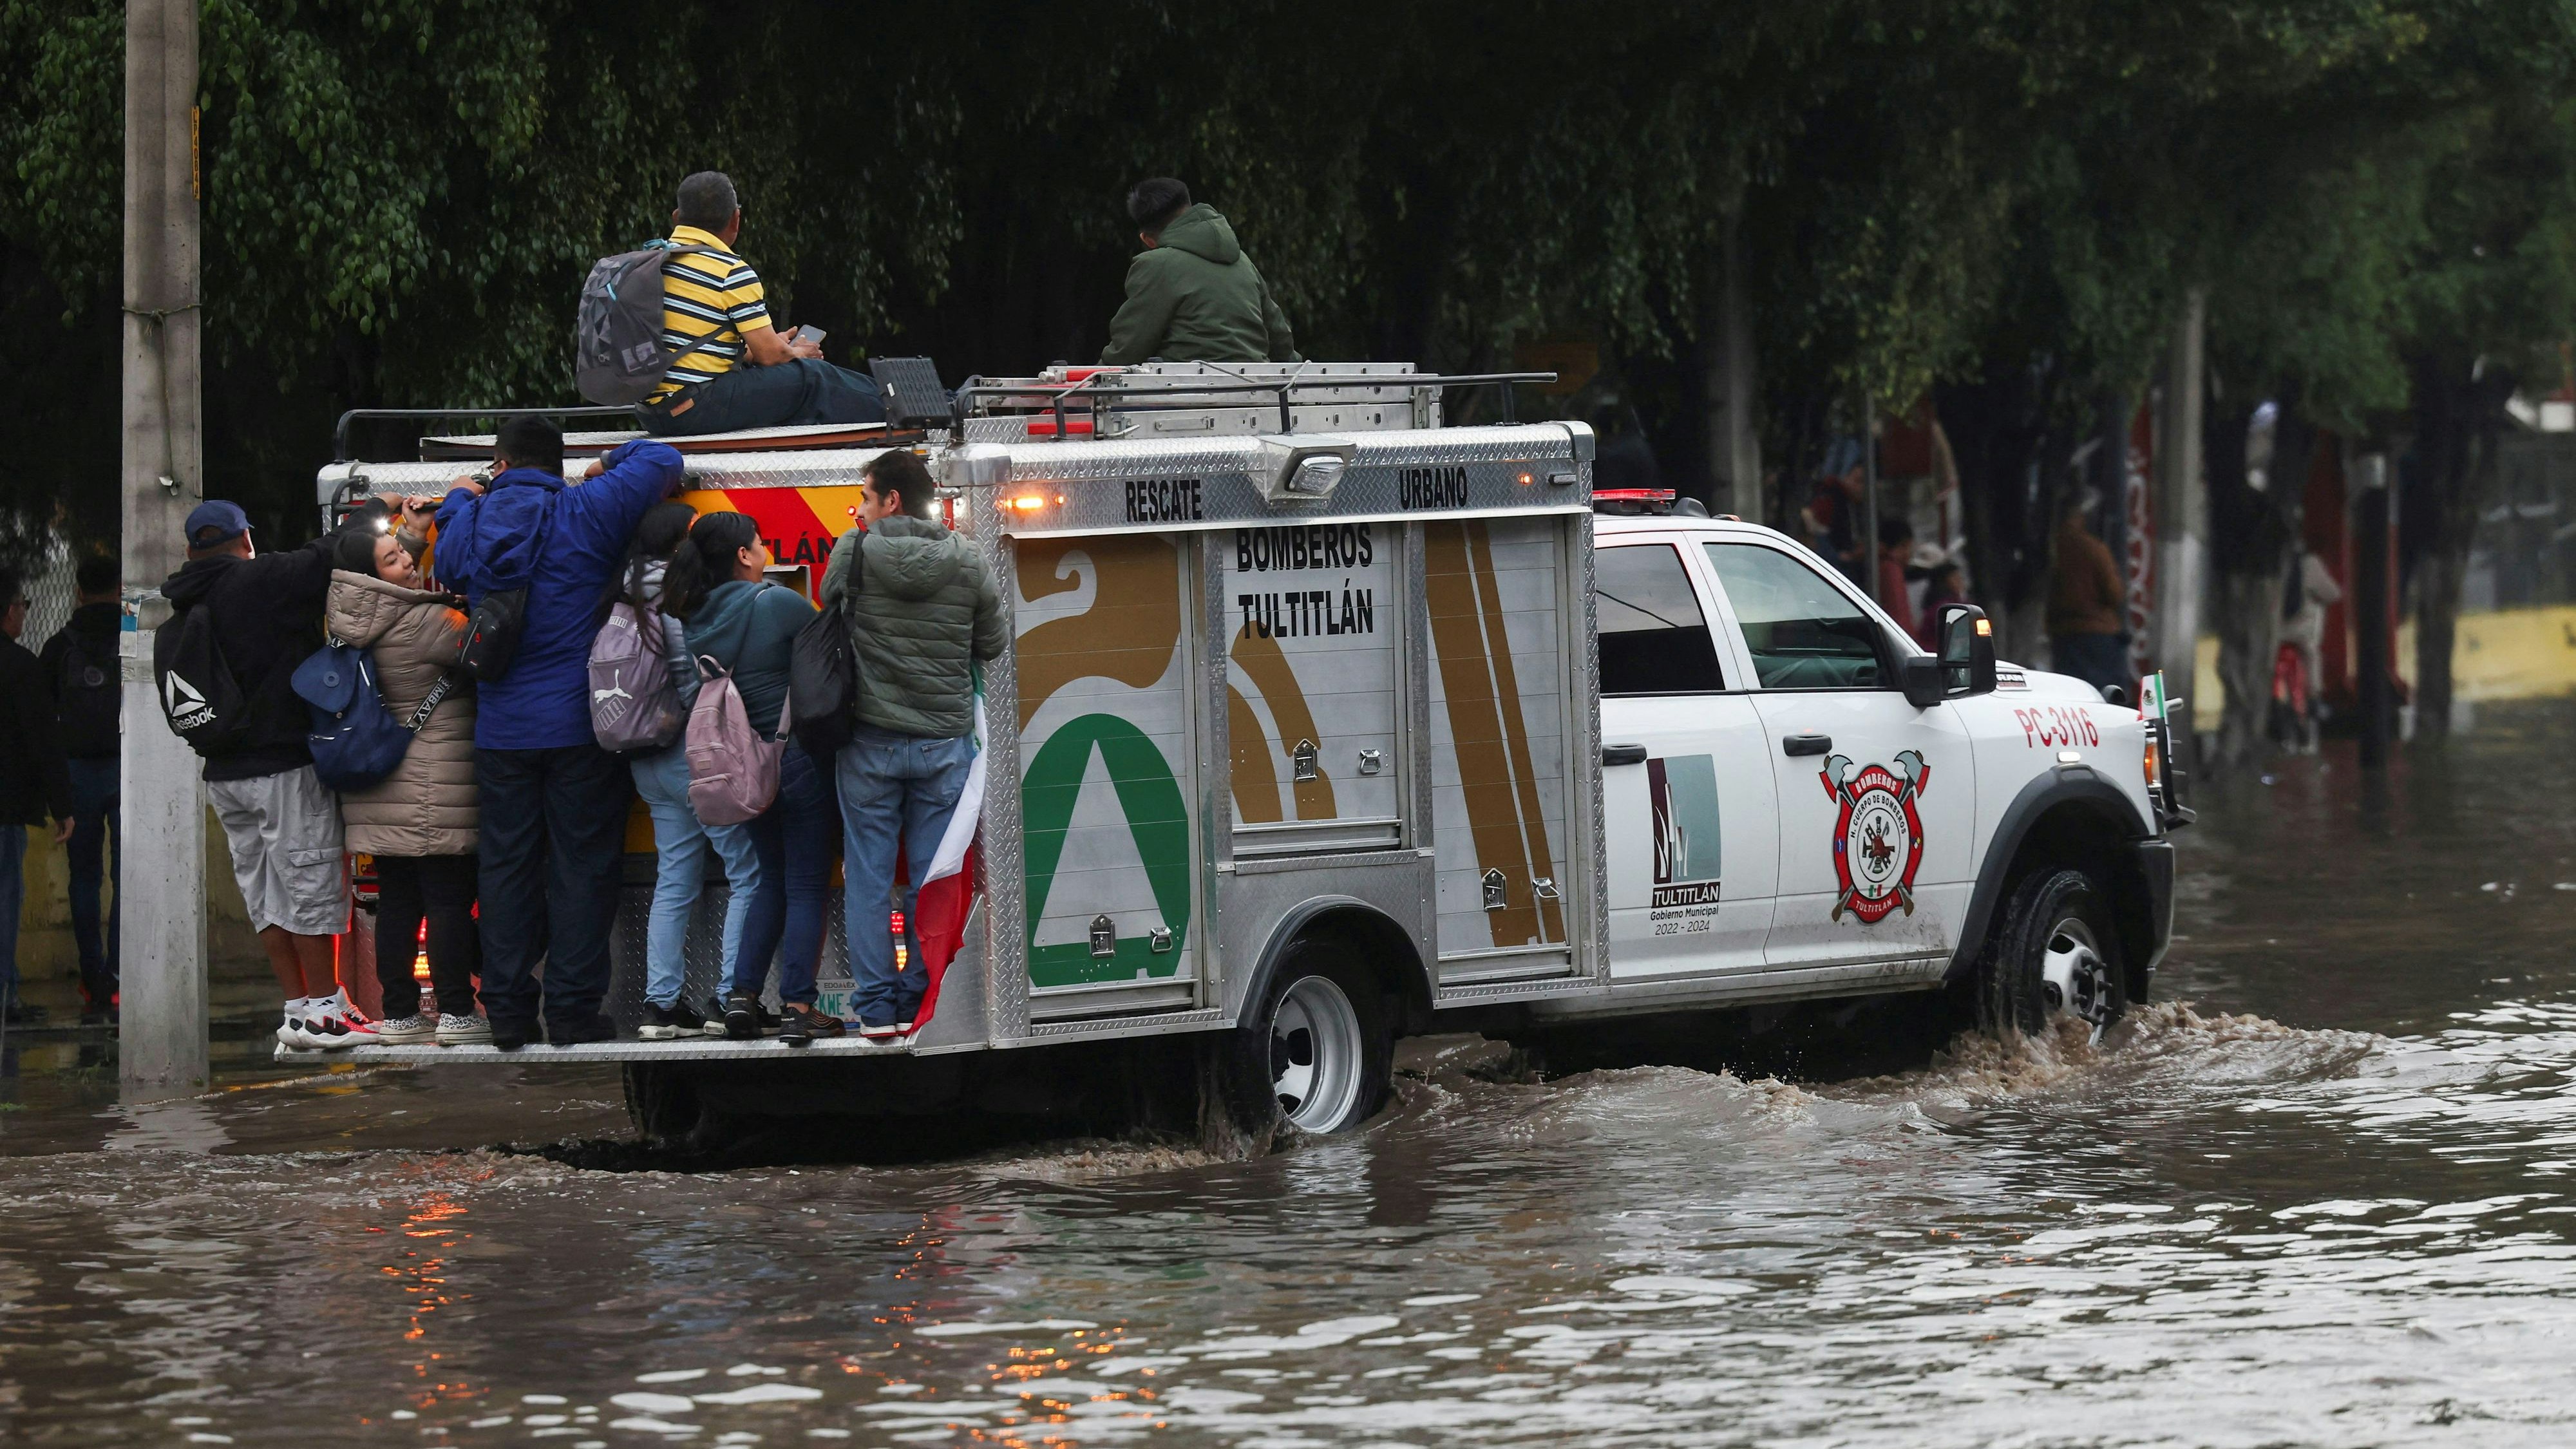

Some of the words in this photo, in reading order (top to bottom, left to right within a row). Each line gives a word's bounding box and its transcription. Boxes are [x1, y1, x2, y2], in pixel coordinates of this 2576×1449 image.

[1125, 479, 1202, 522] RESCATE
[1399, 466, 1467, 511] URBANO
[1236, 524, 1373, 572] BOMBEROS
[1238, 578, 1373, 639] TULTITLÁN
[2014, 707, 2098, 748] PC-3116
[1855, 773, 1897, 793] BOMBEROS
[1853, 797, 1871, 826] CUERPO
[1873, 795, 1880, 804] DE
[1882, 796, 1906, 834] BOMBEROS
[1651, 910, 1683, 921] Gobierno
[1685, 905, 1719, 917] Municipal
[1654, 882, 1719, 906] TULTITLÁN
[1655, 922, 1678, 935] 2022
[1687, 920, 1710, 932] 2024
